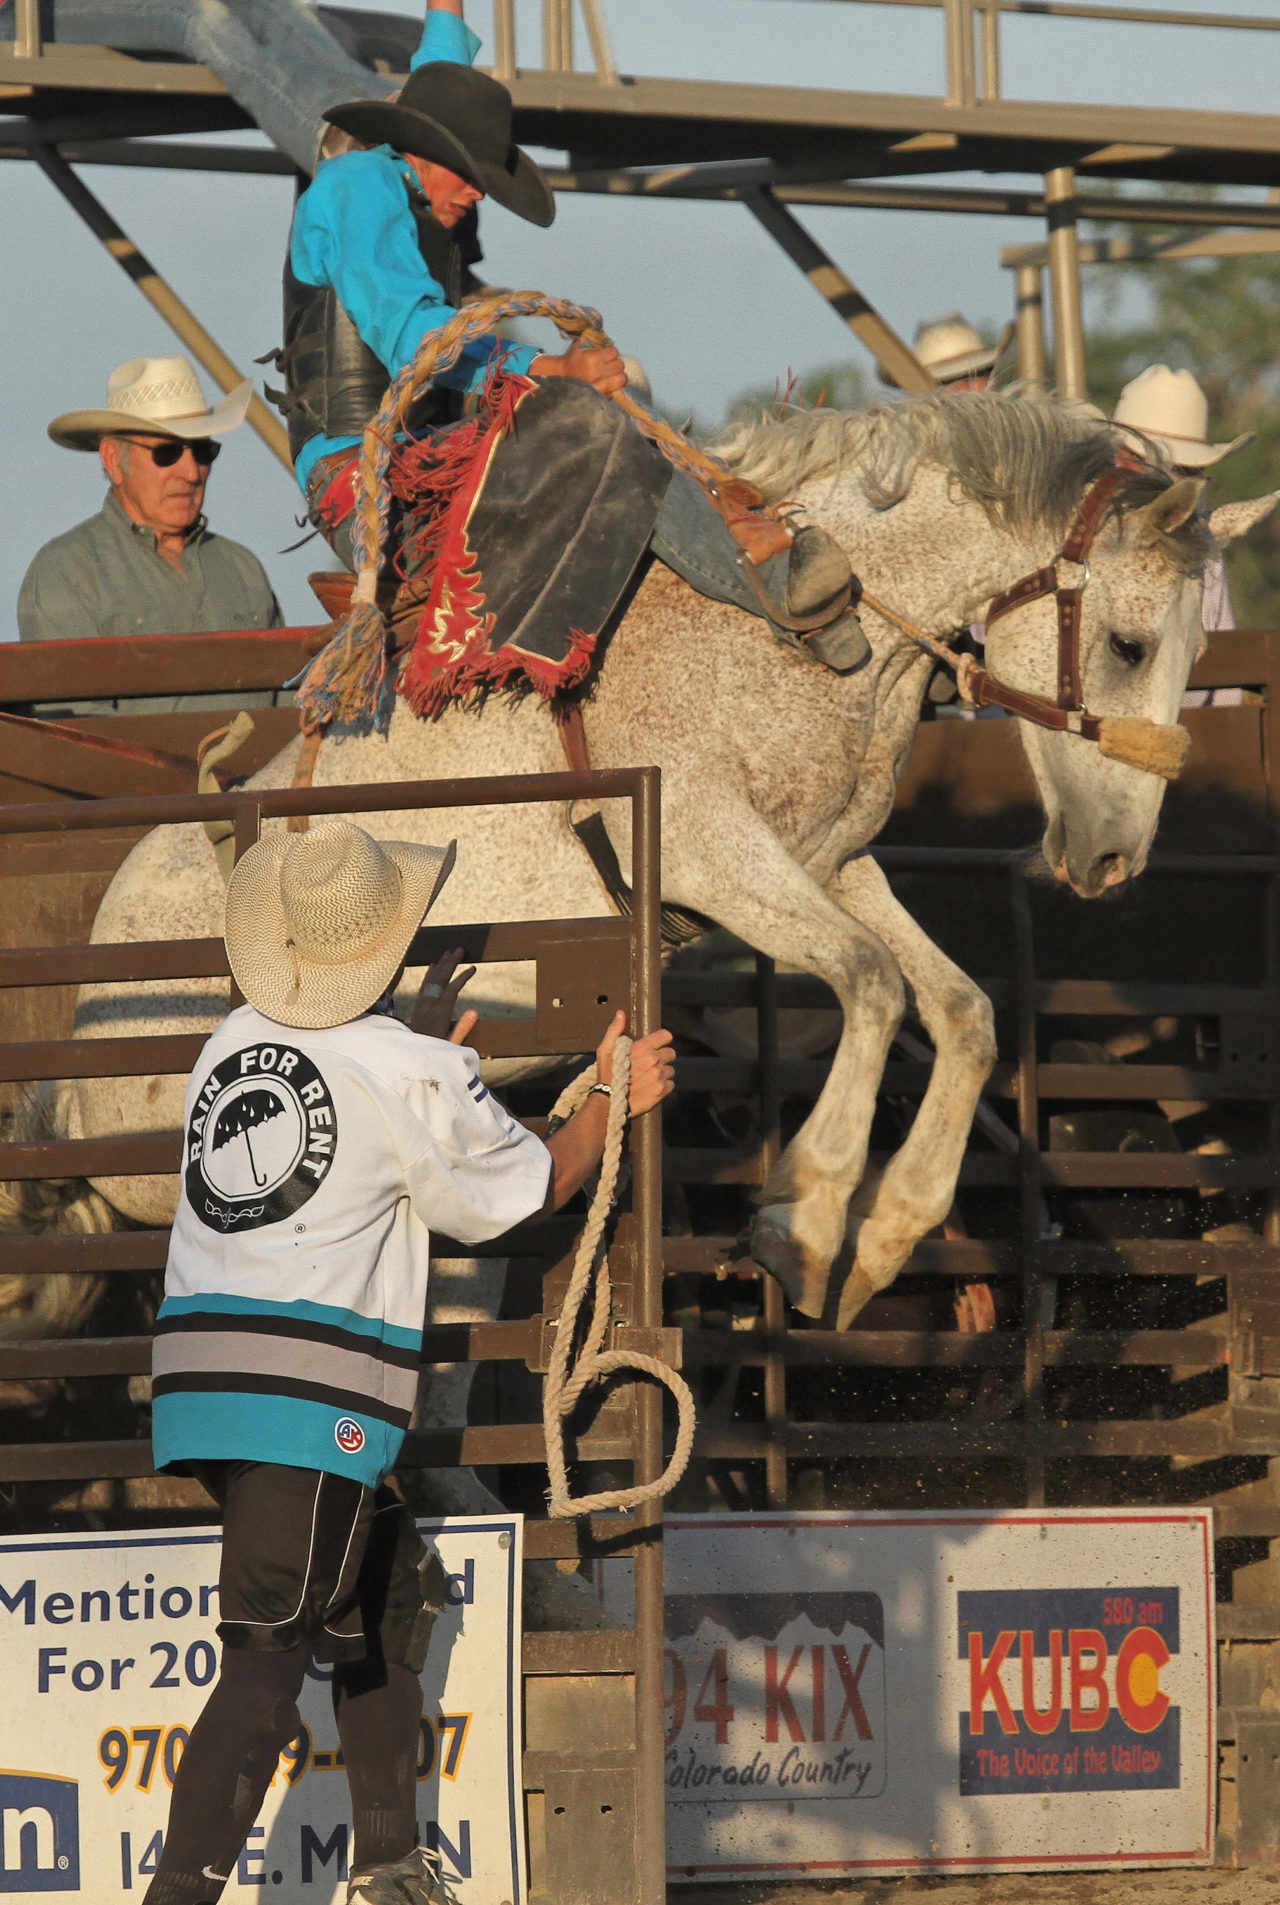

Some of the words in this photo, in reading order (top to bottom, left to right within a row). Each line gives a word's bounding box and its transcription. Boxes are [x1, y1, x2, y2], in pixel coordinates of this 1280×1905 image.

[190, 1074, 223, 1163] RAIN
[239, 1047, 299, 1077] FOR
[300, 1078, 333, 1179] RENT
[1103, 1597, 1133, 1625] 580
[1138, 1602, 1164, 1624] am
[38, 1647, 135, 1693] For
[764, 1643, 874, 1743] KIX
[968, 1626, 1171, 1735] KUBC
[778, 1746, 872, 1794] Country
[977, 1749, 1010, 1777] The
[1014, 1747, 1060, 1776] Voice
[1064, 1746, 1080, 1774] of
[1084, 1746, 1107, 1773] the
[1112, 1744, 1161, 1773] Valley
[301, 1820, 472, 1883] MN
